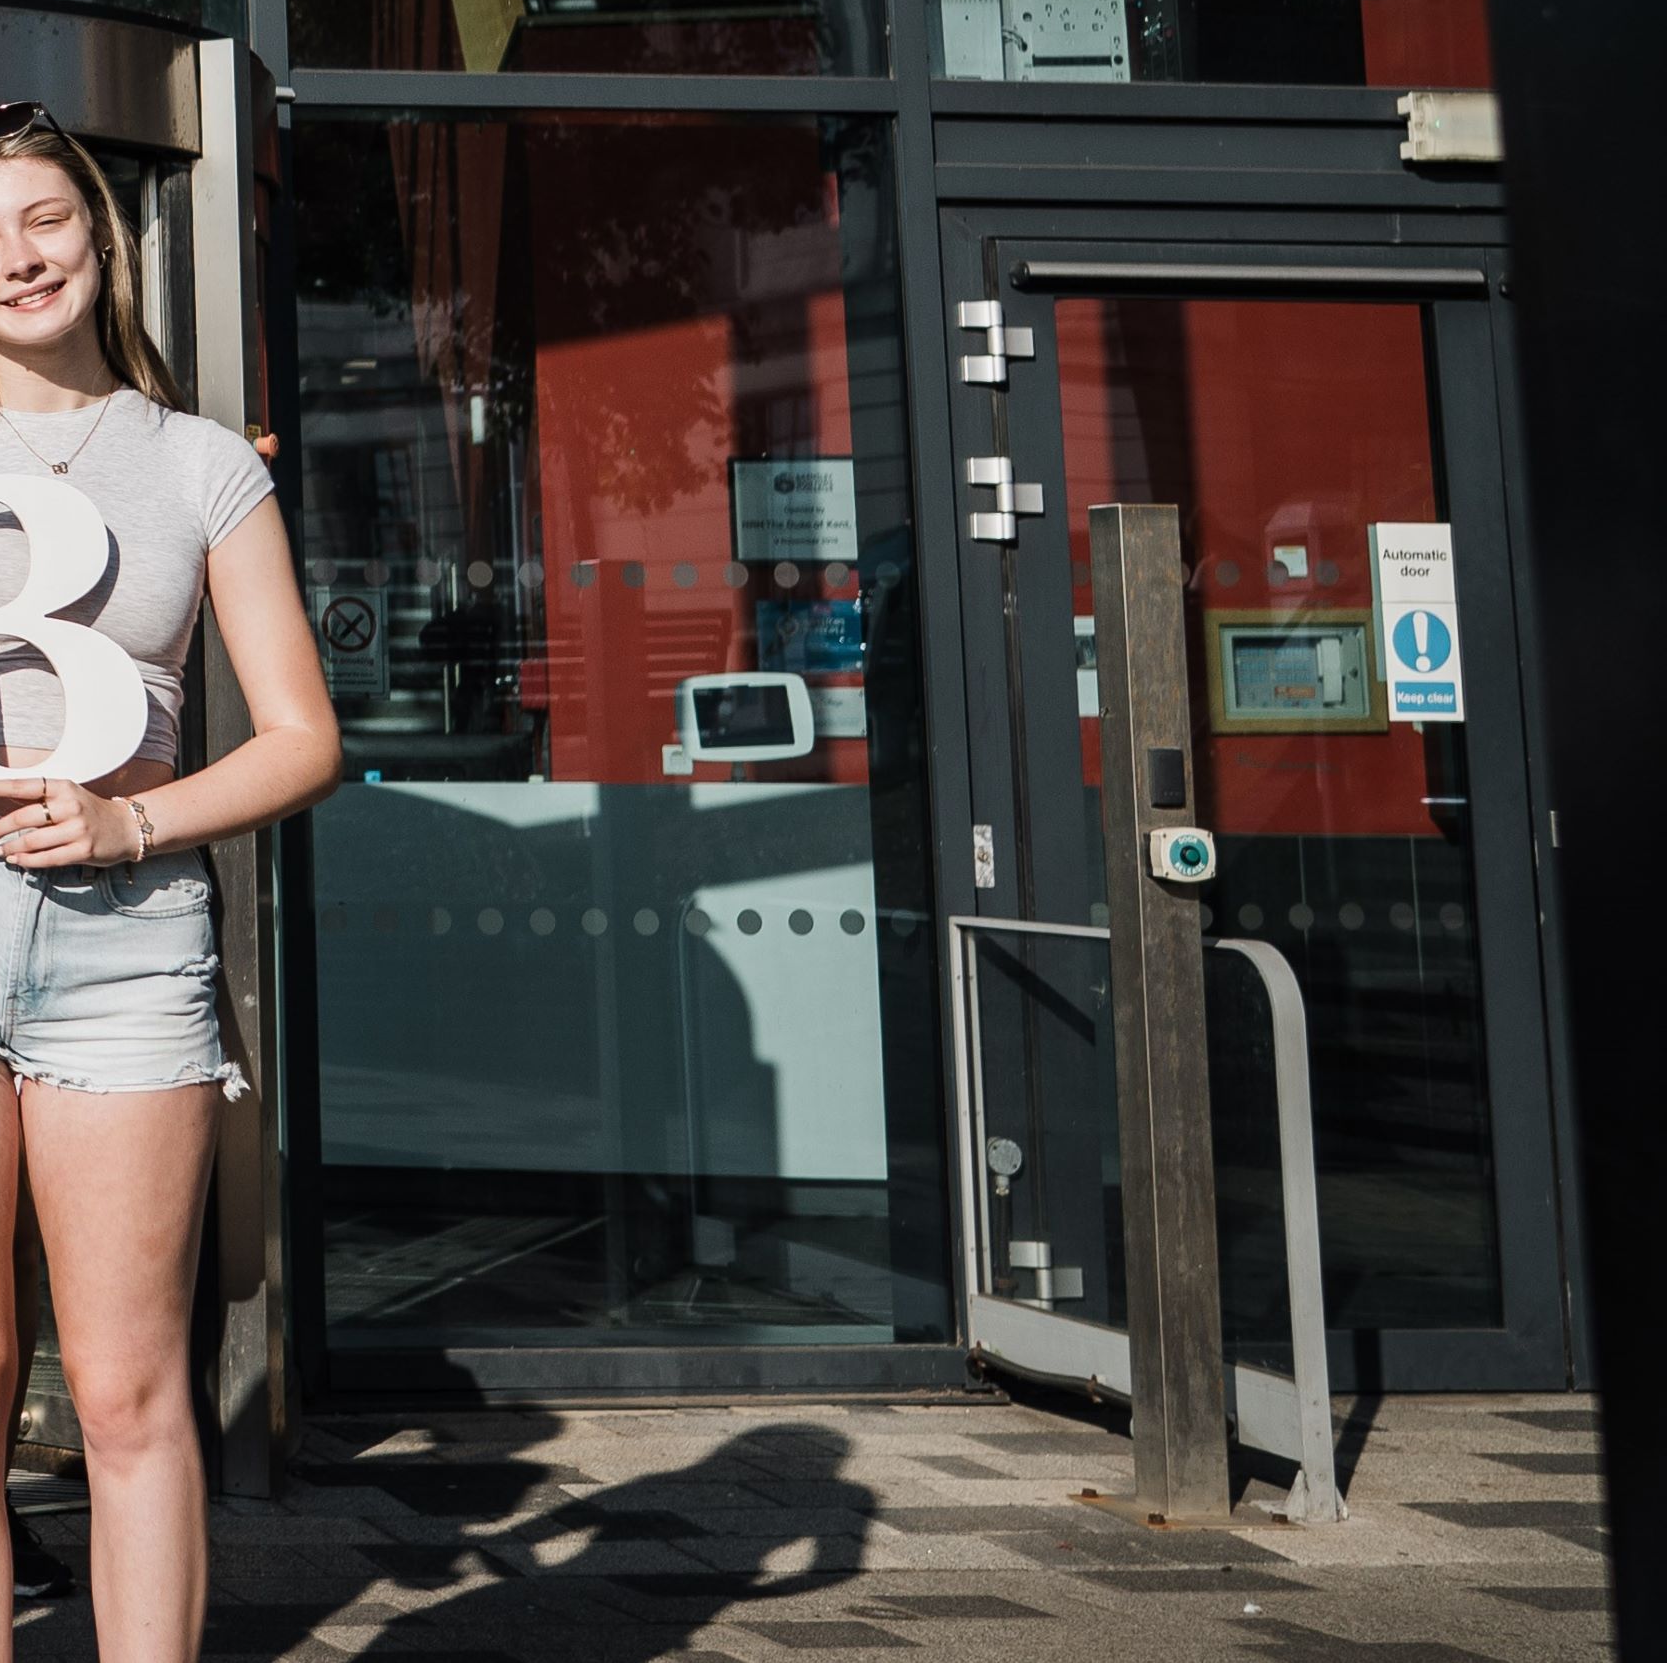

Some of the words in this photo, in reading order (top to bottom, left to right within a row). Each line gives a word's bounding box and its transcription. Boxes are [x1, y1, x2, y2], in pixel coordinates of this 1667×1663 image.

[1382, 548, 1447, 562] Automatic
[1400, 565, 1431, 577] door
[1396, 690, 1425, 704] Keep
[1426, 691, 1455, 704] clear
